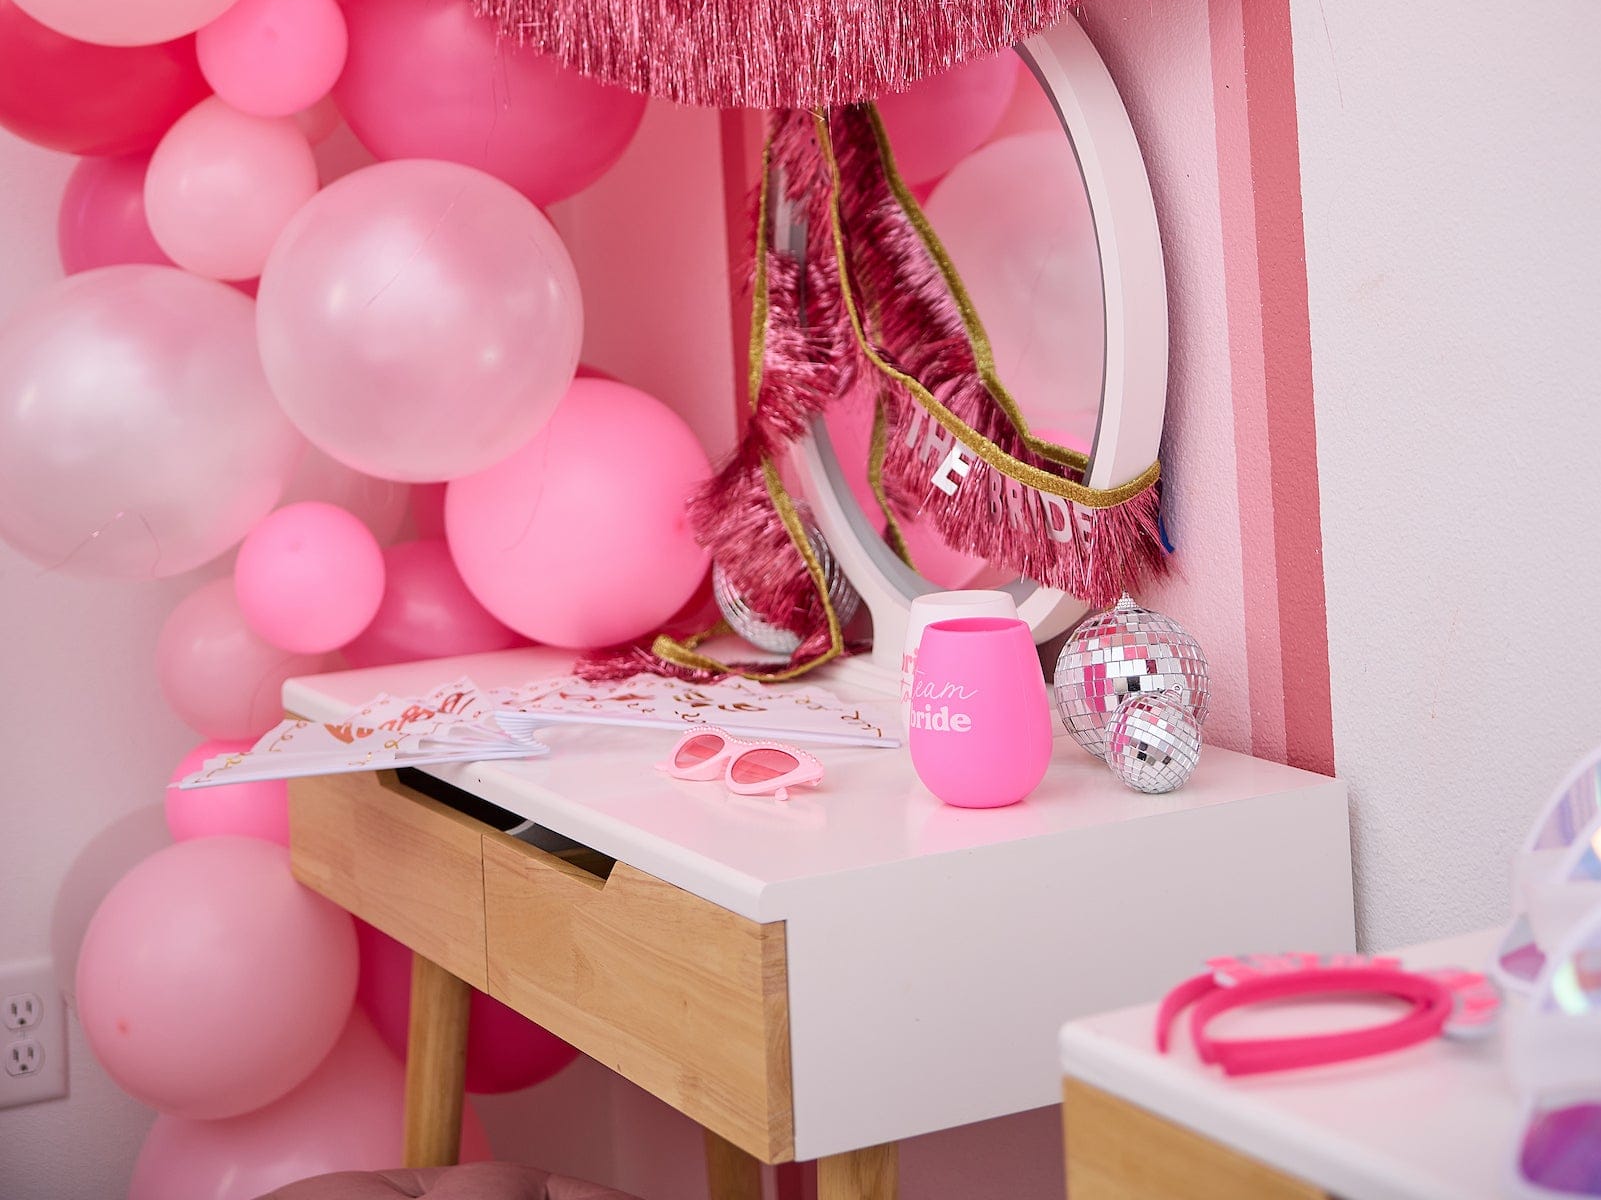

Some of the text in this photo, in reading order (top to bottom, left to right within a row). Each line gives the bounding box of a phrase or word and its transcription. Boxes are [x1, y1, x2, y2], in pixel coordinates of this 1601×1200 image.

[904, 395, 1097, 552] THE BRIDE
[910, 703, 972, 732] bride
